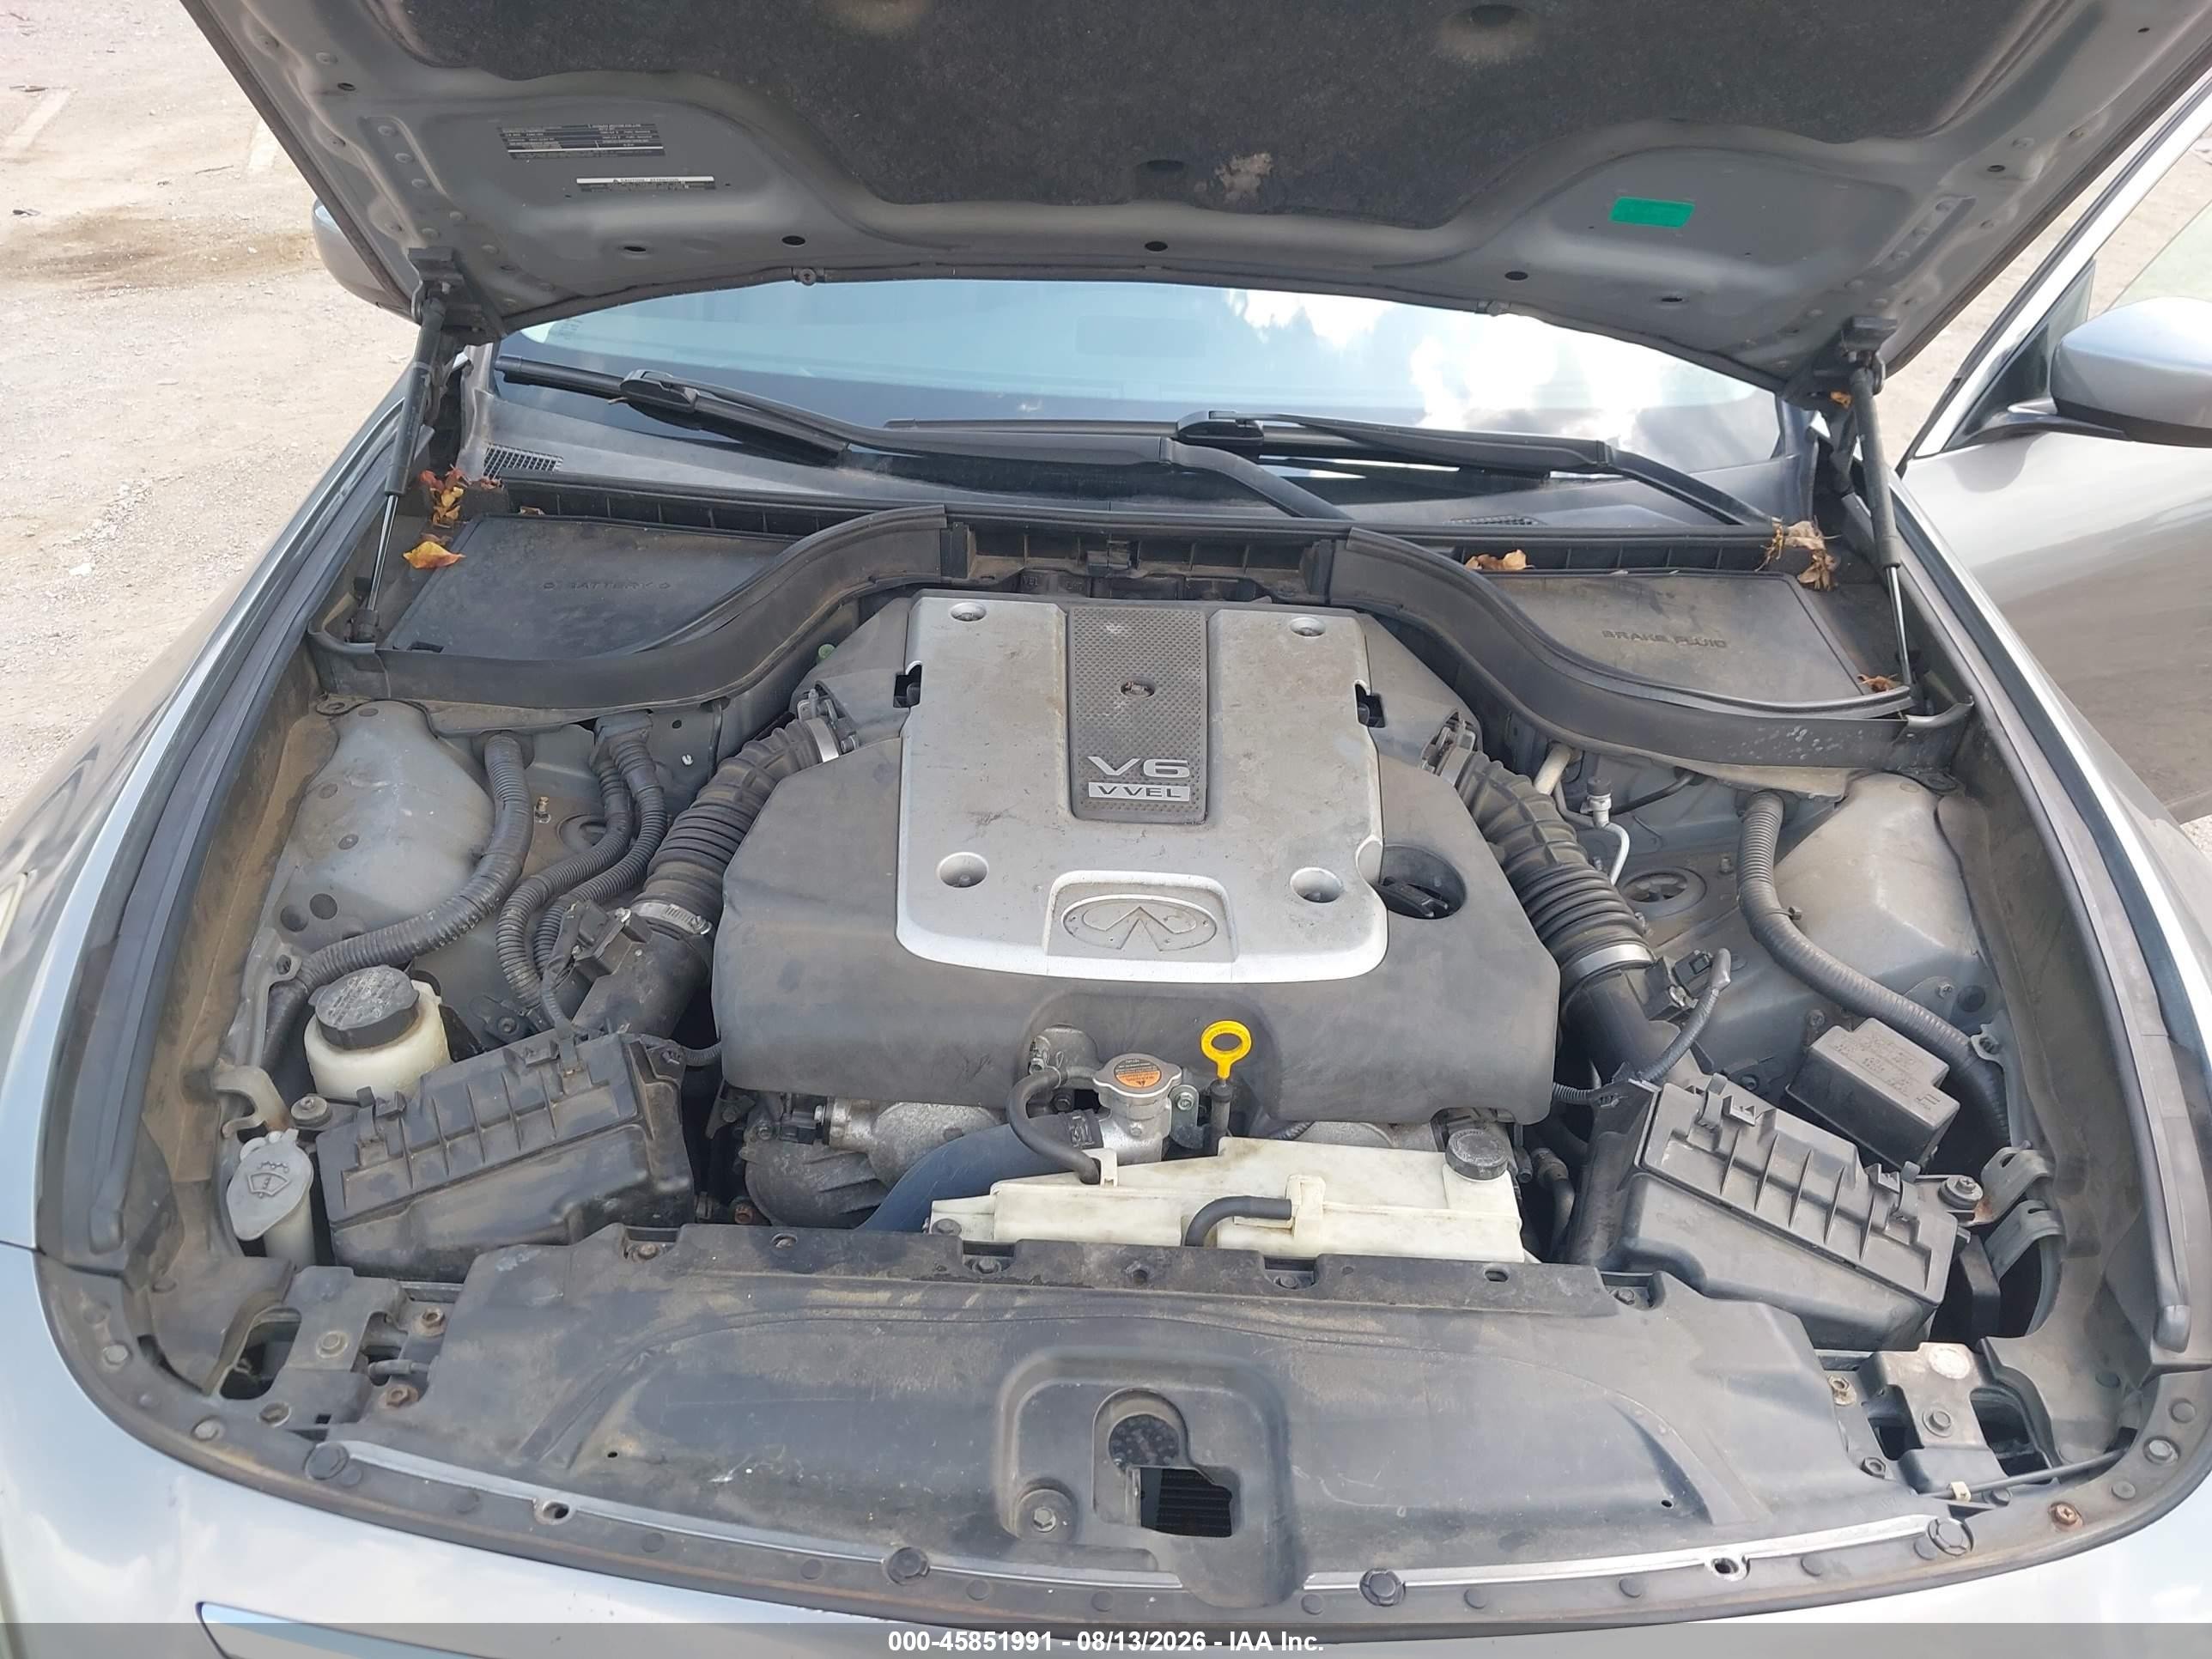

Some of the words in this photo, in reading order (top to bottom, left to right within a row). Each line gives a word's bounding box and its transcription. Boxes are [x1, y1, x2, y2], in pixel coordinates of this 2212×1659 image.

[1601, 629, 1669, 643] BRAKE
[1674, 635, 1728, 648] FLUID
[1087, 756, 1190, 778] V6
[1097, 785, 1182, 799] VVEL
